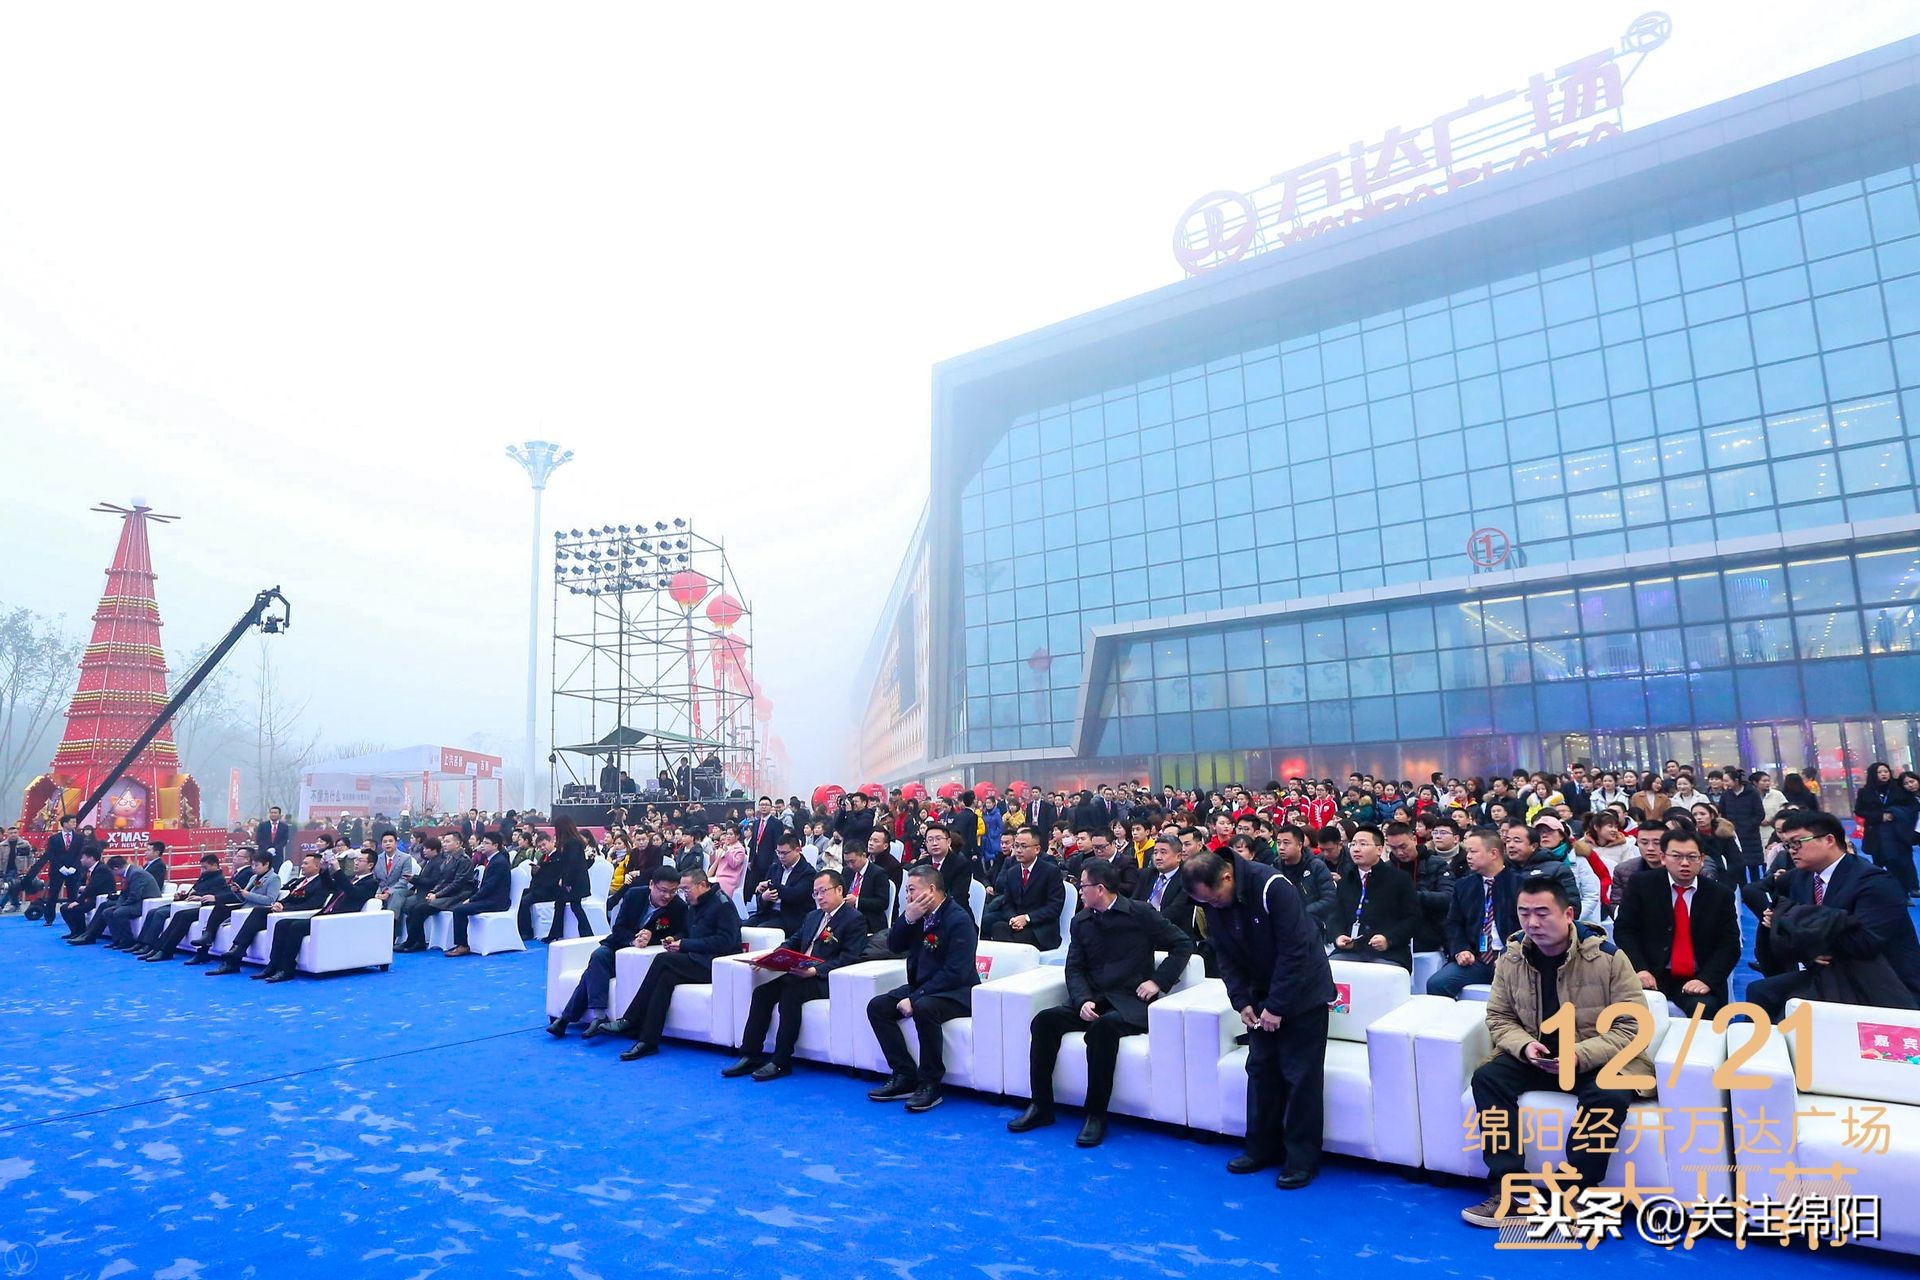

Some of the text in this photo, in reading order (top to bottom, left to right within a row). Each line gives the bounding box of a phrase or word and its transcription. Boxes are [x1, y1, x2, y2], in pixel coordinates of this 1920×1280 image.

[1270, 47, 1625, 223] 万达广场
[107, 831, 150, 843] X'MAS
